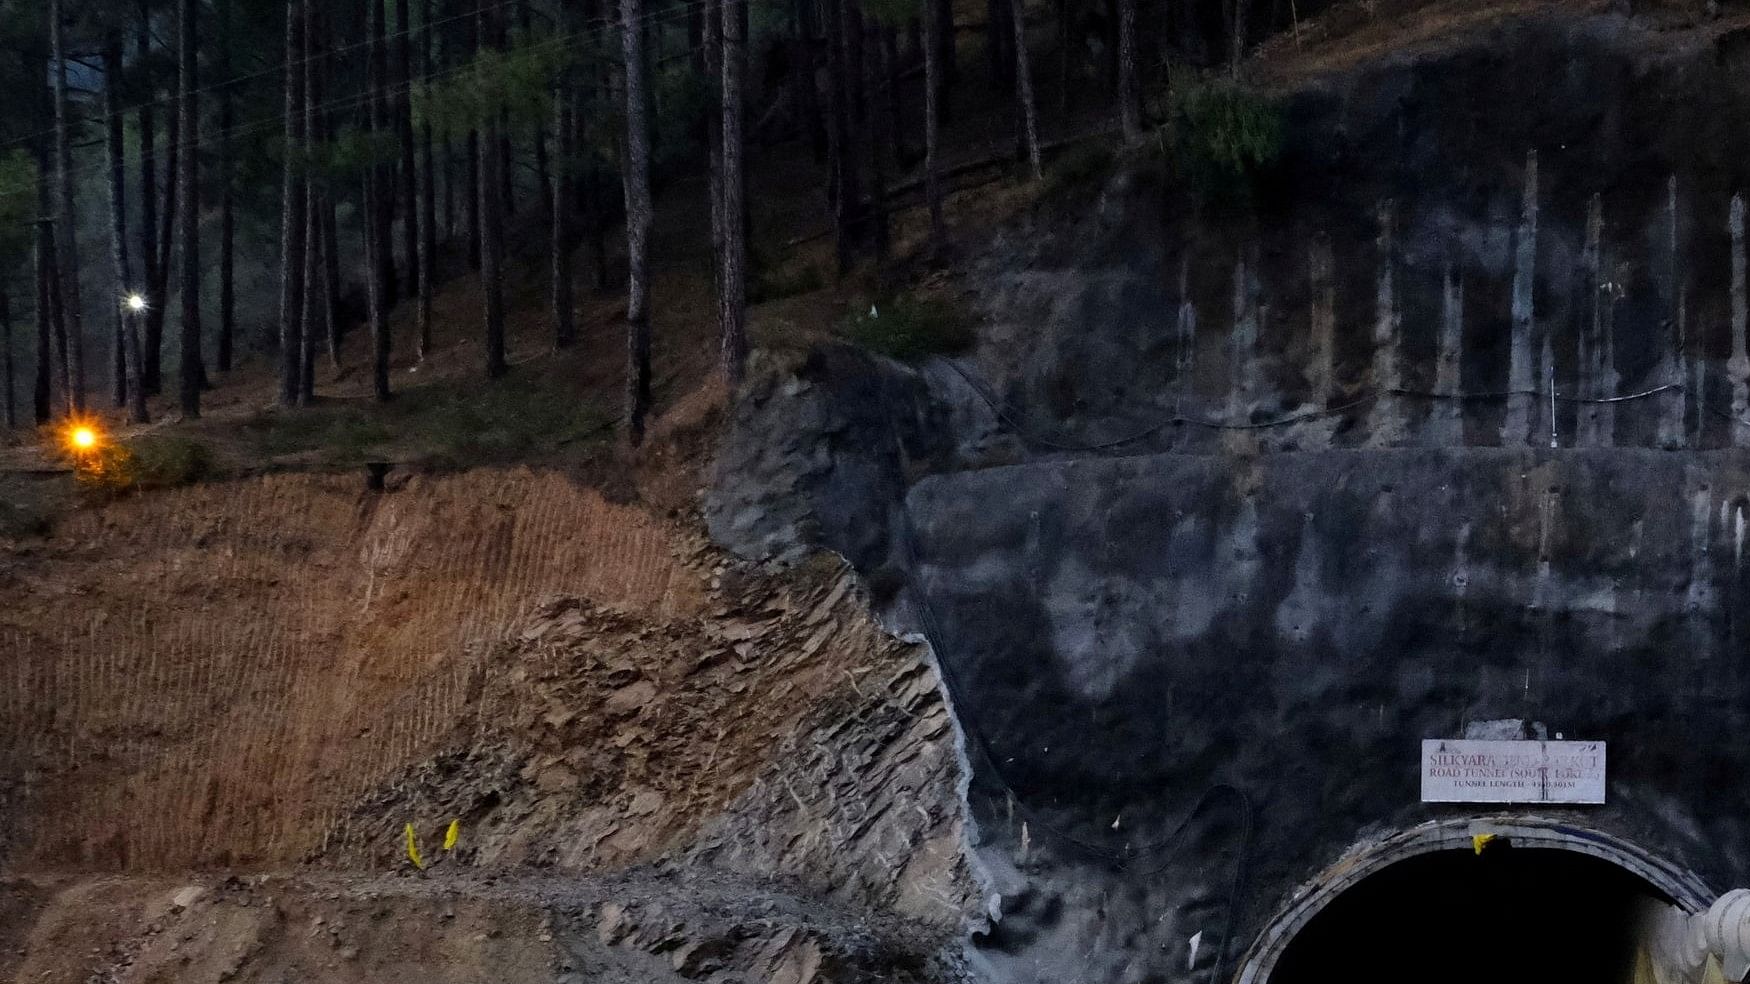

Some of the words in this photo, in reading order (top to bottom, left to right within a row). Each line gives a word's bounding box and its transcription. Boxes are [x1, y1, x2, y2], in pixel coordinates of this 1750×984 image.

[1429, 768, 1460, 777] ROAD
[1453, 780, 1486, 788] TUNNEL
[1489, 780, 1525, 788] LENGTH
